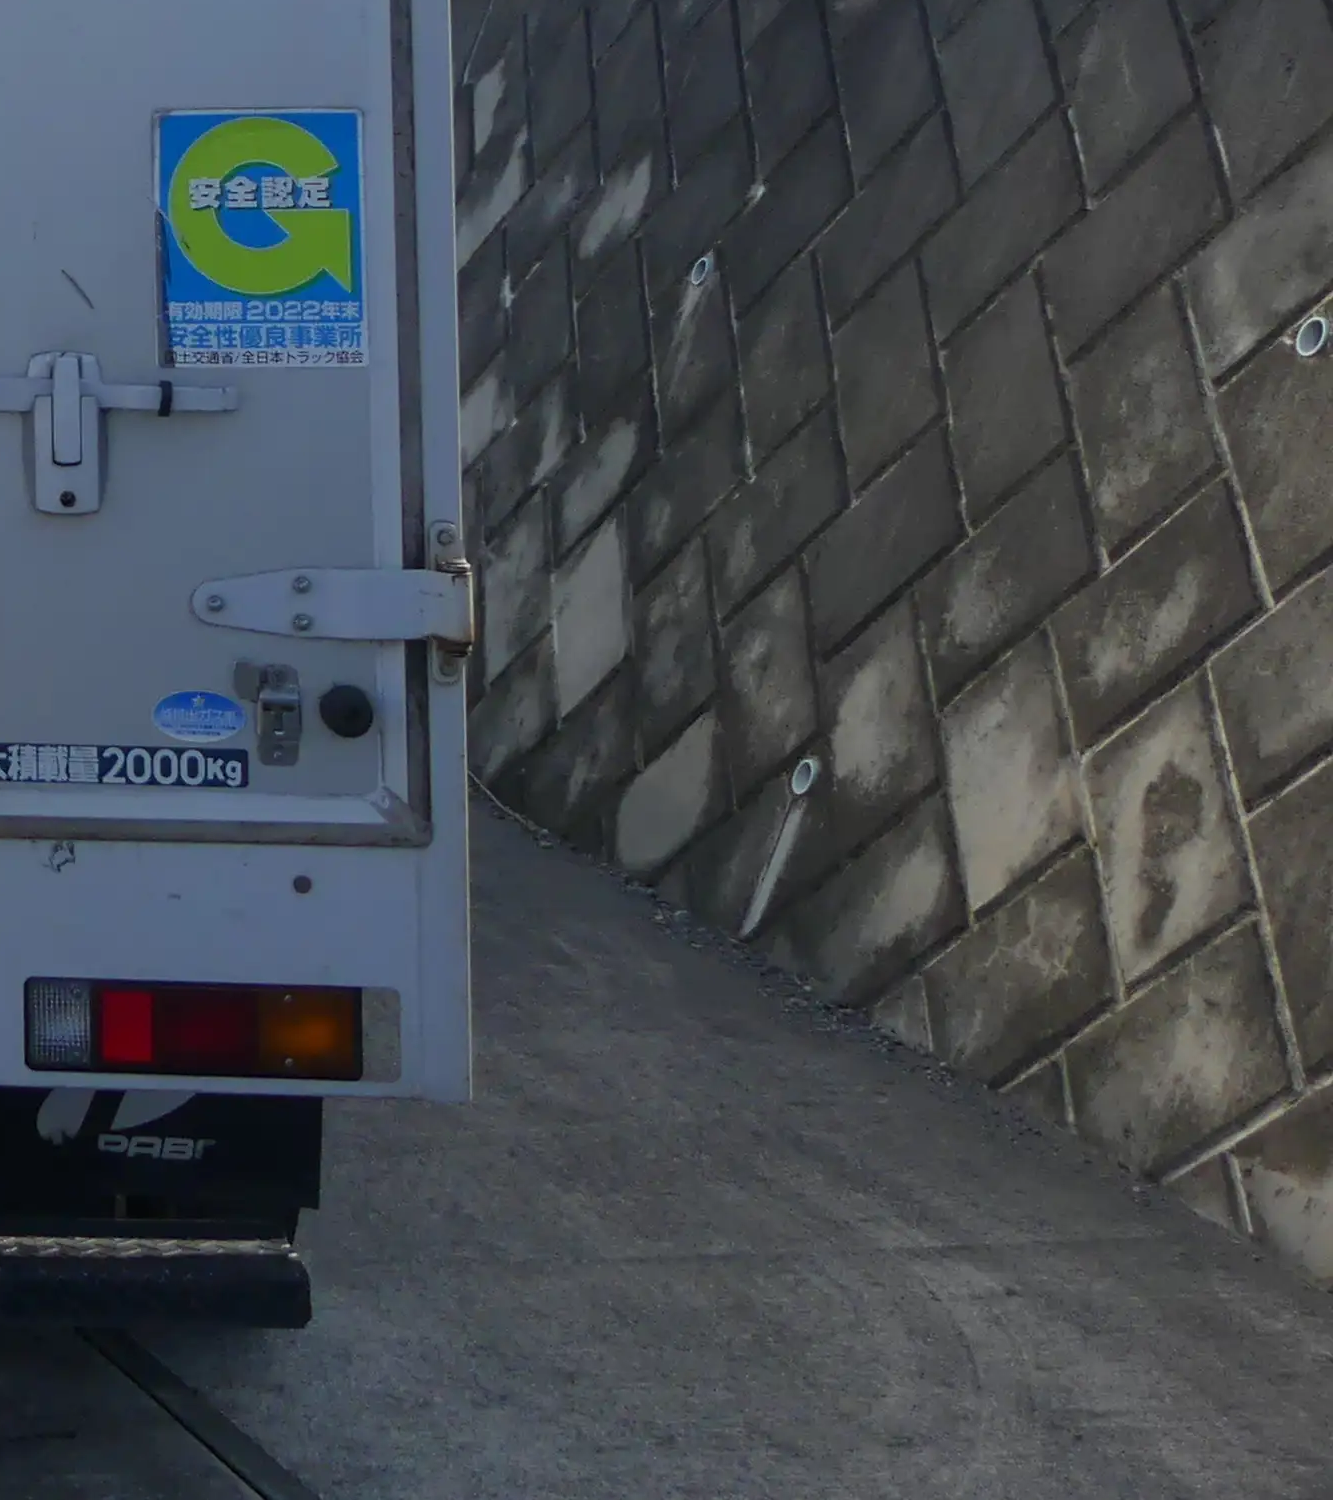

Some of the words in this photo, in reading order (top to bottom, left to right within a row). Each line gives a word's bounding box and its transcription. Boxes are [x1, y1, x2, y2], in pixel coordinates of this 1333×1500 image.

[188, 175, 331, 210] 安全認定
[168, 324, 362, 350] 安全性優良事業所
